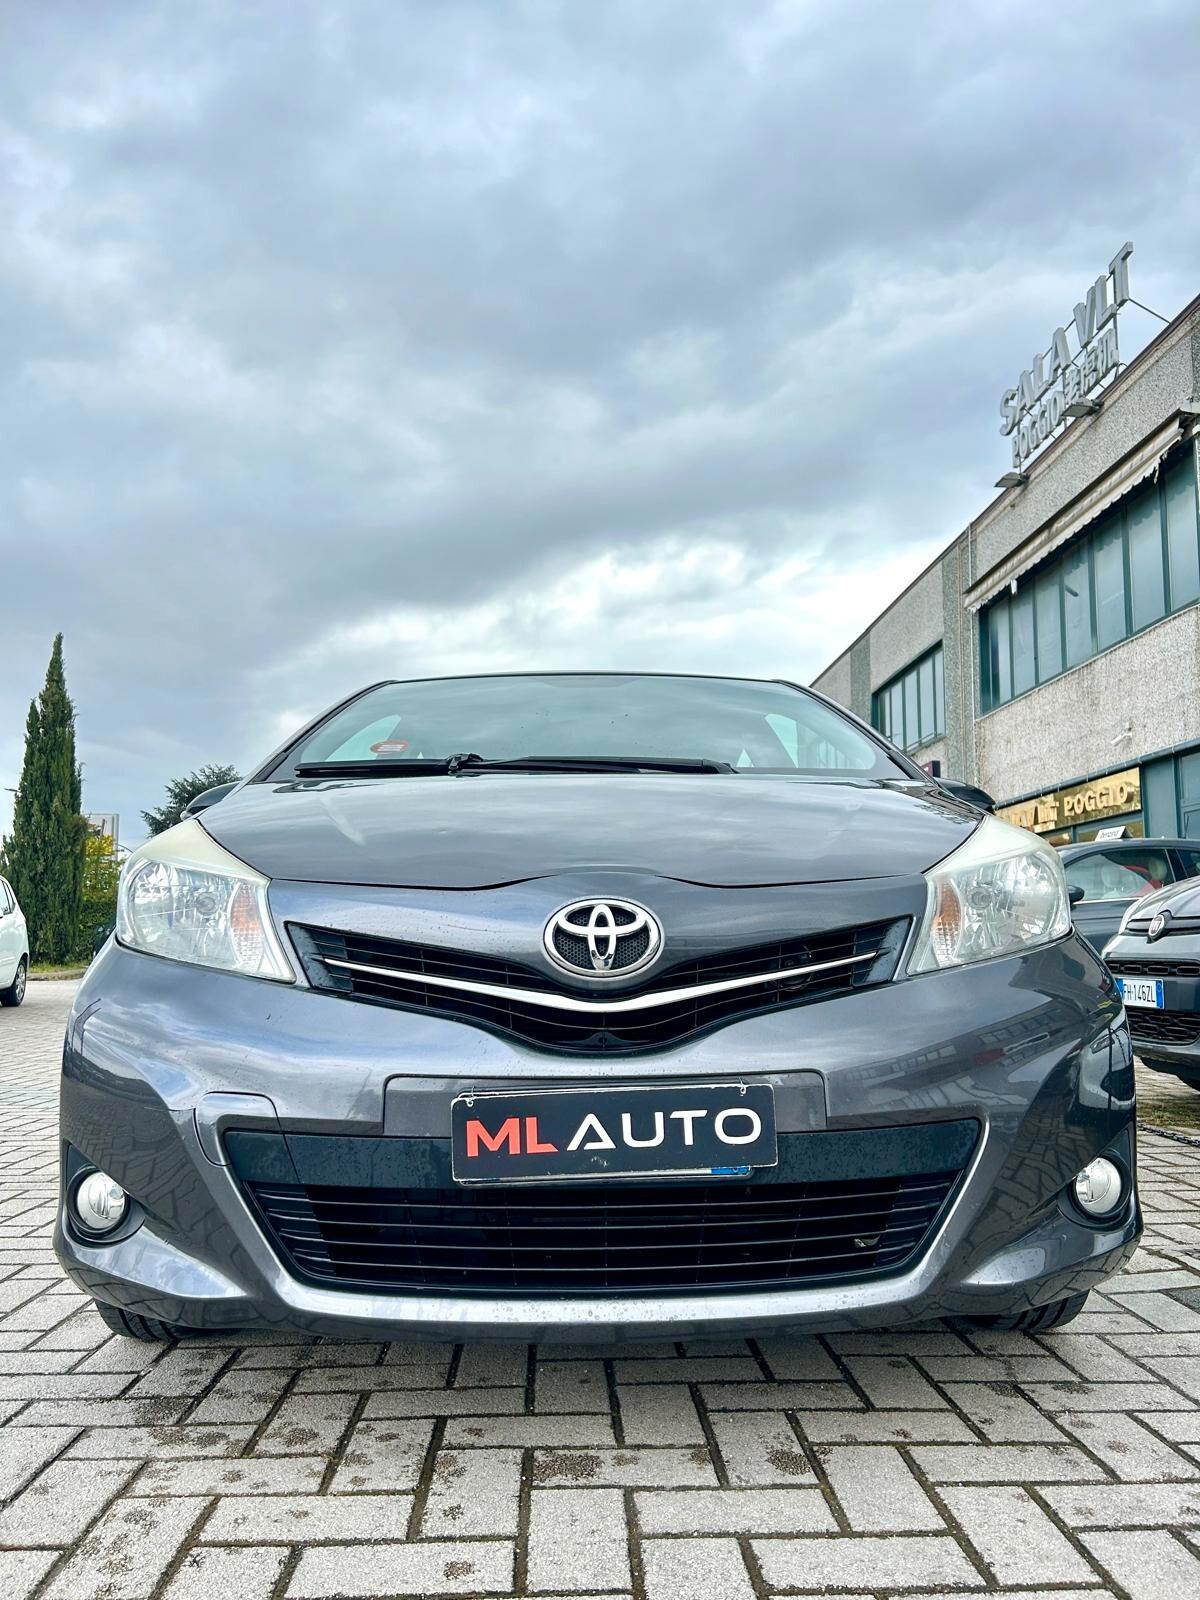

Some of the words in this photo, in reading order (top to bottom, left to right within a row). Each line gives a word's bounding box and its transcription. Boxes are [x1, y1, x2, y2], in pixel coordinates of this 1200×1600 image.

[1000, 327, 1071, 436] SALA
[1073, 241, 1134, 349] VLT
[1012, 390, 1065, 468] POGGIO
[1063, 784, 1128, 817] POGGIO
[466, 1115, 559, 1157] ML
[566, 1107, 762, 1151] AUTO
